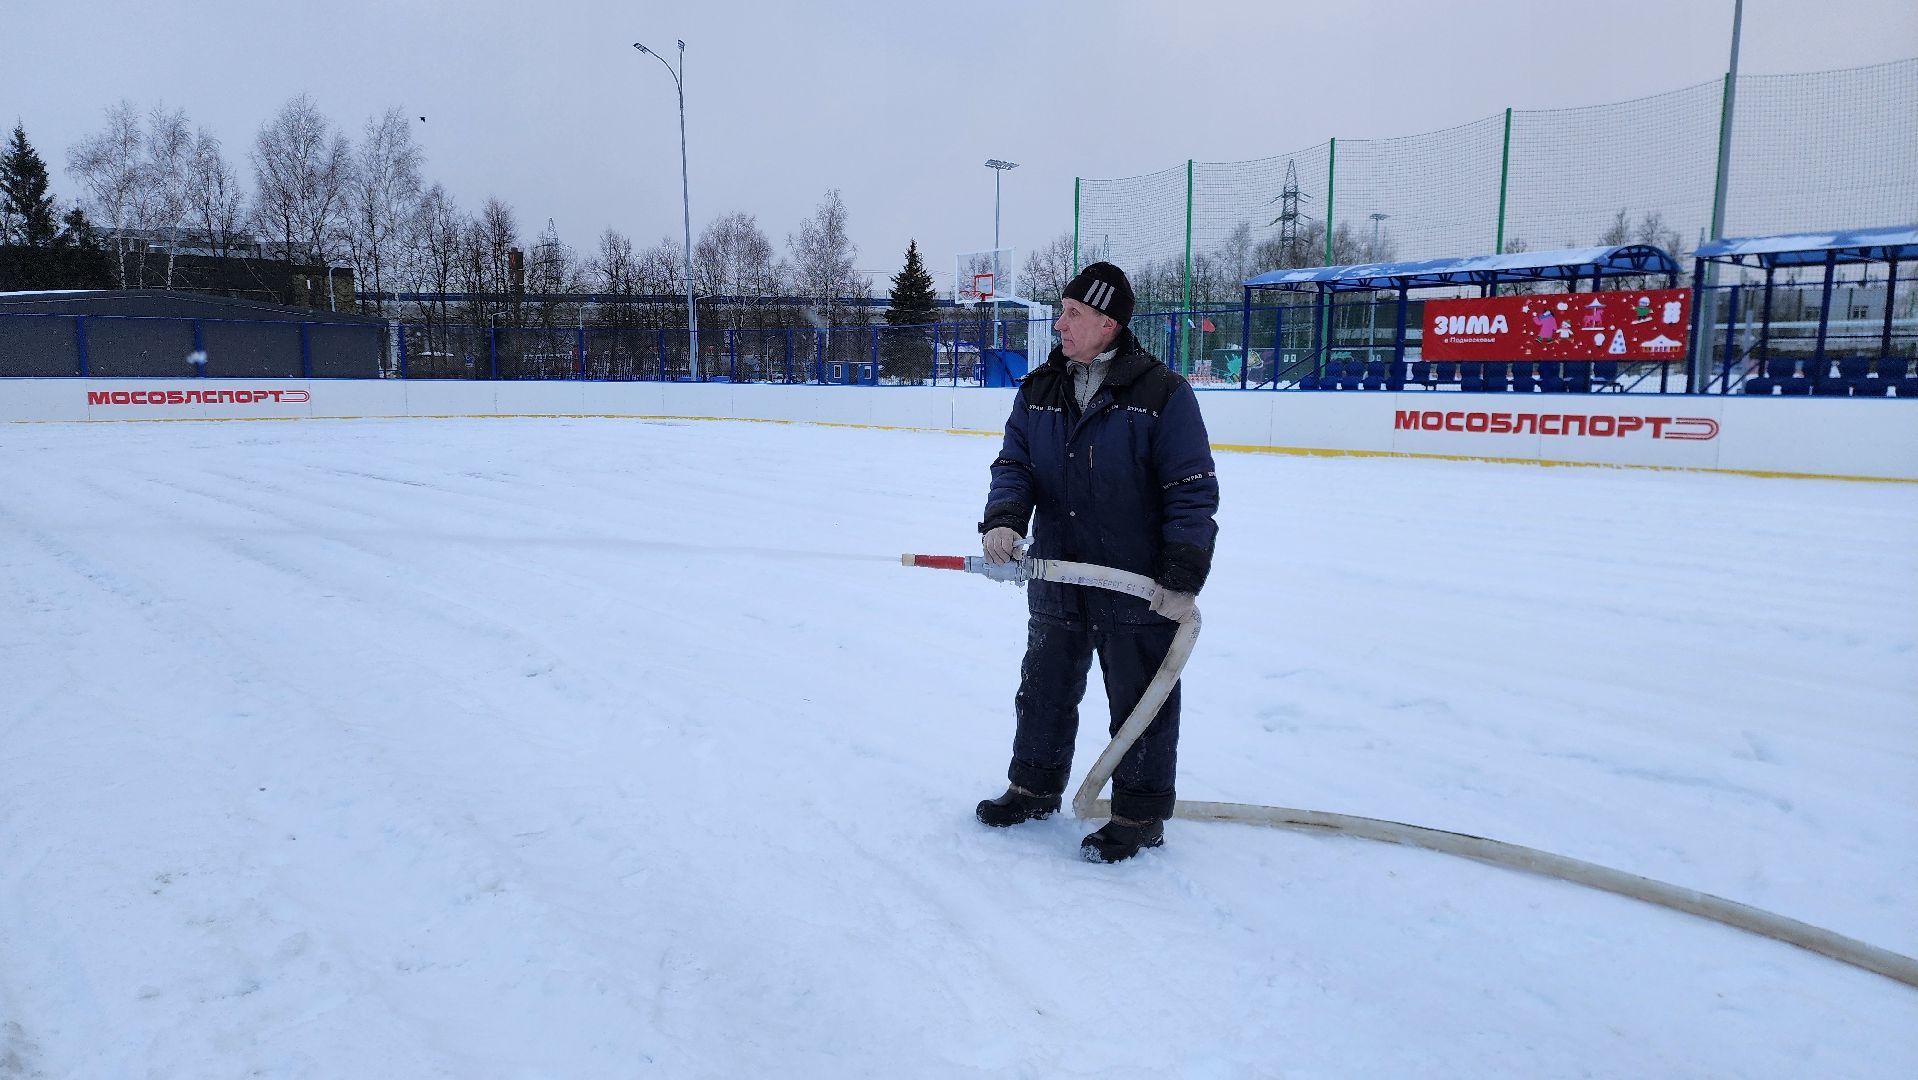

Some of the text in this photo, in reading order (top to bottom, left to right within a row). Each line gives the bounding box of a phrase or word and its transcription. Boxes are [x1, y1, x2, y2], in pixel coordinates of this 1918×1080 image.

[1434, 314, 1509, 335] ЗИМА
[88, 390, 284, 406] МОСОБЛСПОРТ
[1394, 410, 1672, 440] МОСОБЛСПОРТ
